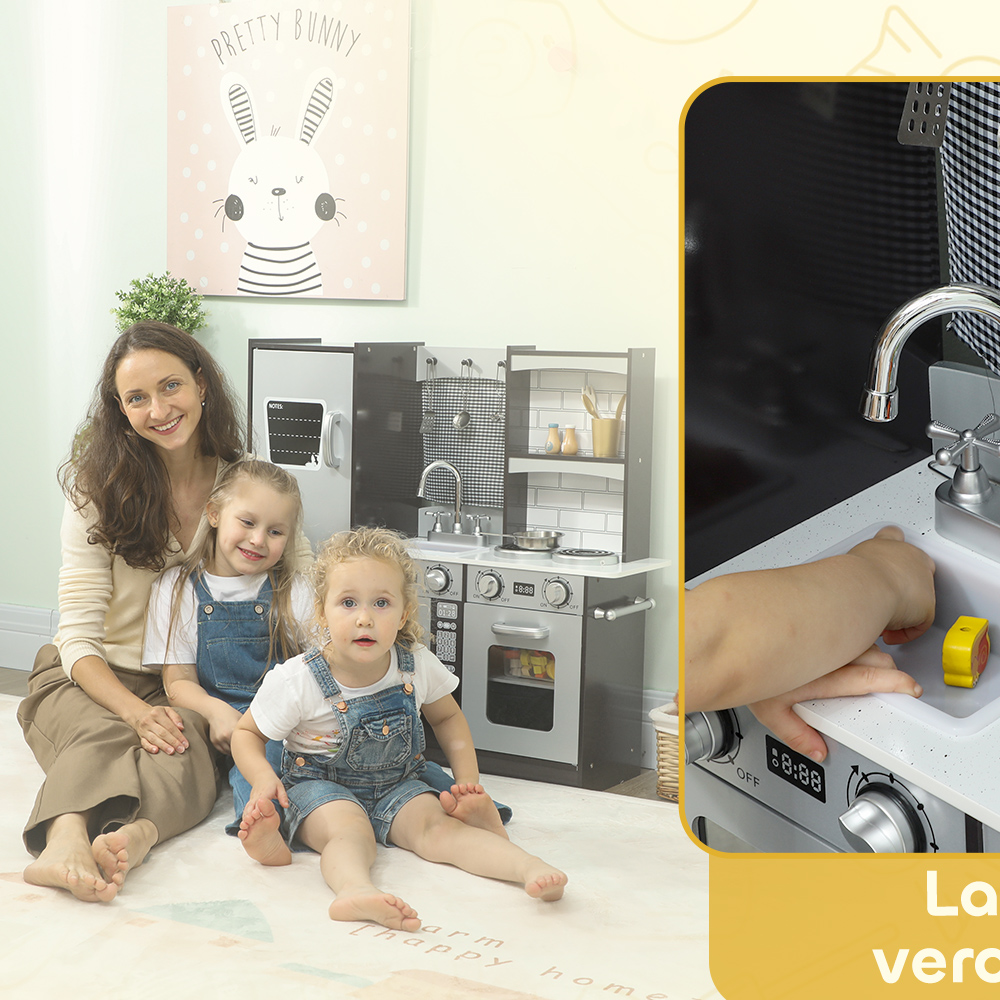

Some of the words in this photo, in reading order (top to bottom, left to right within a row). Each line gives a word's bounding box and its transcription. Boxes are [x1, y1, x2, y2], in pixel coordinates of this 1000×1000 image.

[211, 12, 280, 65] PRETTY
[295, 9, 361, 57] BUNNY
[737, 767, 760, 788] OFF
[420, 921, 505, 948] arm
